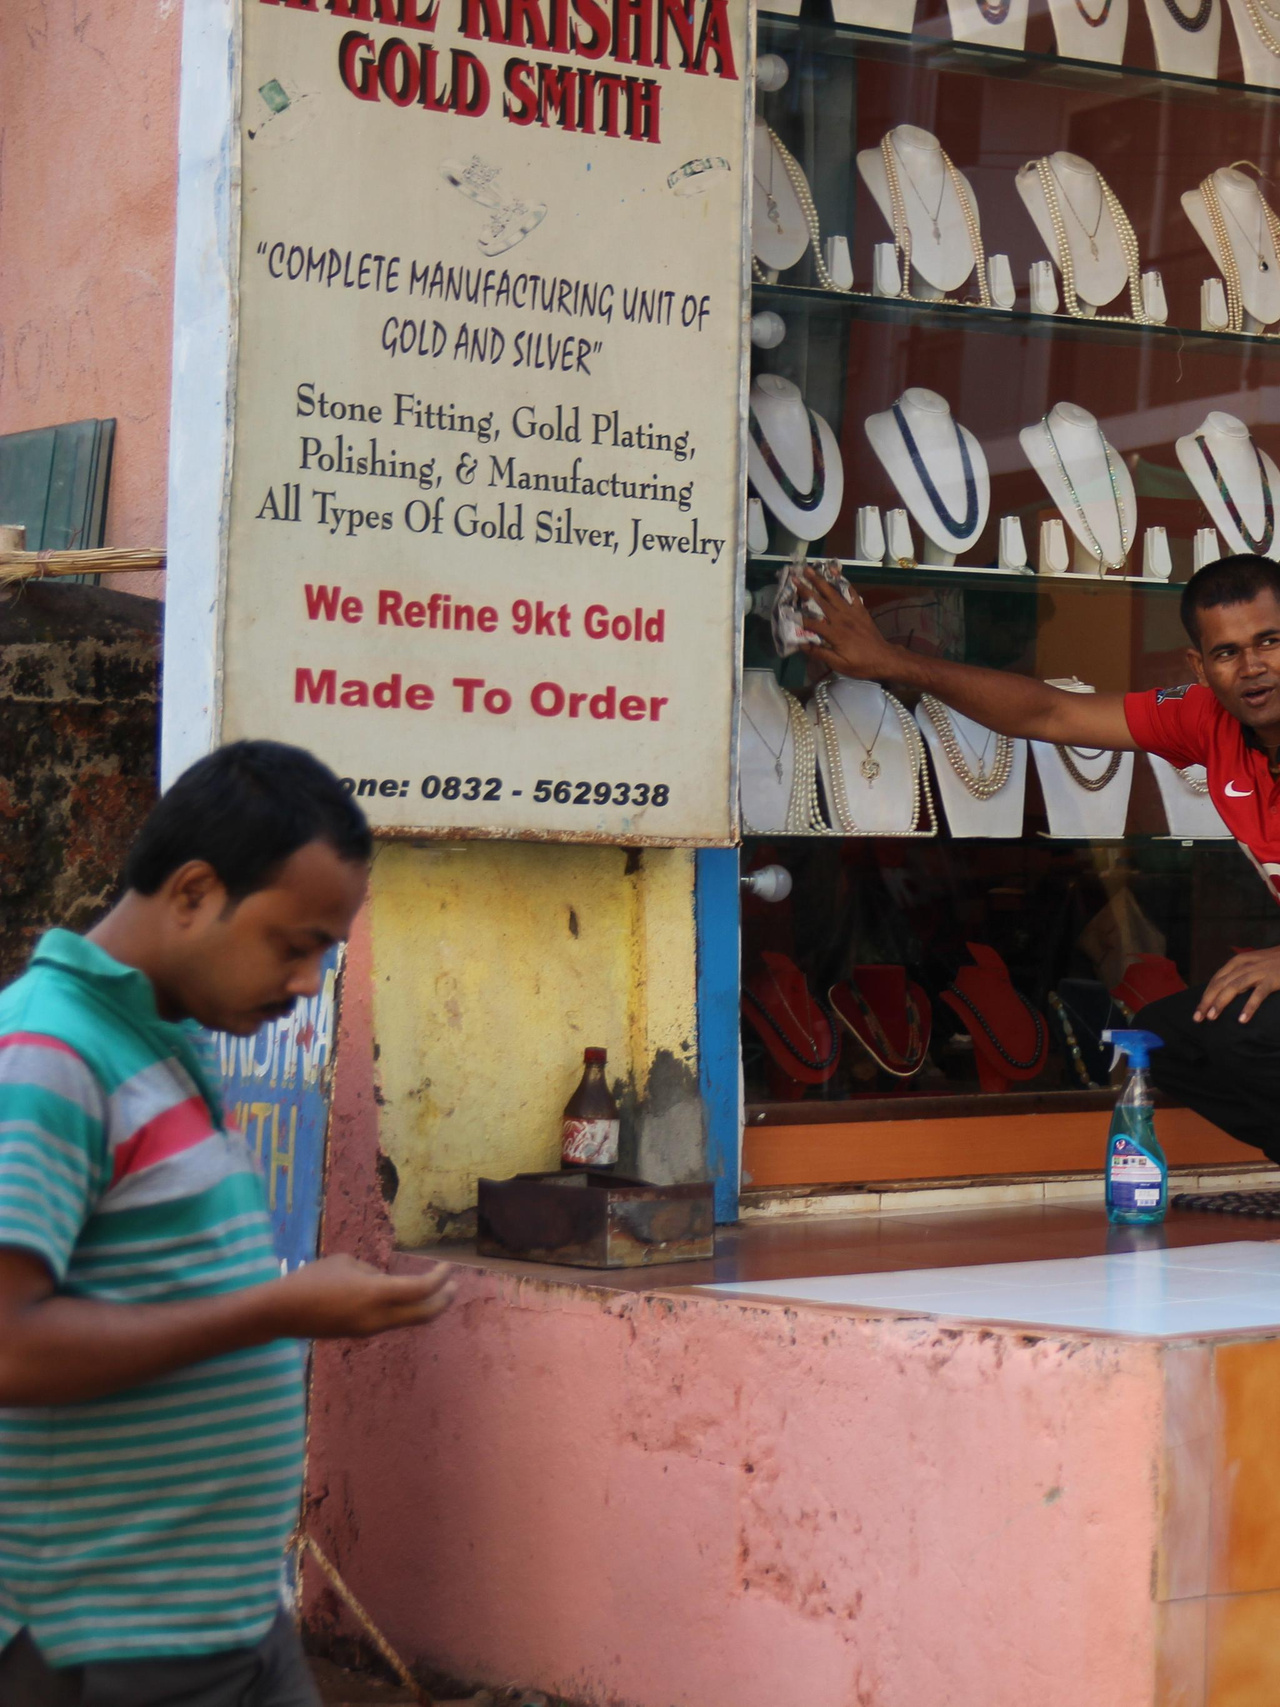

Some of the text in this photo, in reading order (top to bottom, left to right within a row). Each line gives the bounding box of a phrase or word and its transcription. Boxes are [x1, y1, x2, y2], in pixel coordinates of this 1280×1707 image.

[339, 30, 662, 144] GOLD SMITH
[410, 260, 614, 324] MANUFACTURING
[623, 287, 675, 325] UNIT
[681, 295, 710, 331] OF
[382, 317, 447, 358] GOLD
[454, 322, 505, 364] AND
[297, 383, 695, 462] Stone Fitting, Gold Plating,
[299, 434, 694, 512] Polishing, & Manufacturing
[255, 483, 726, 564] All Types Of Gold Silver, Jewelry
[304, 584, 665, 643] We Refine 9kt Gold
[295, 668, 669, 721] Made To Order
[338, 777, 409, 797] one:
[421, 775, 502, 801] 0832
[533, 780, 669, 807] 5629338
